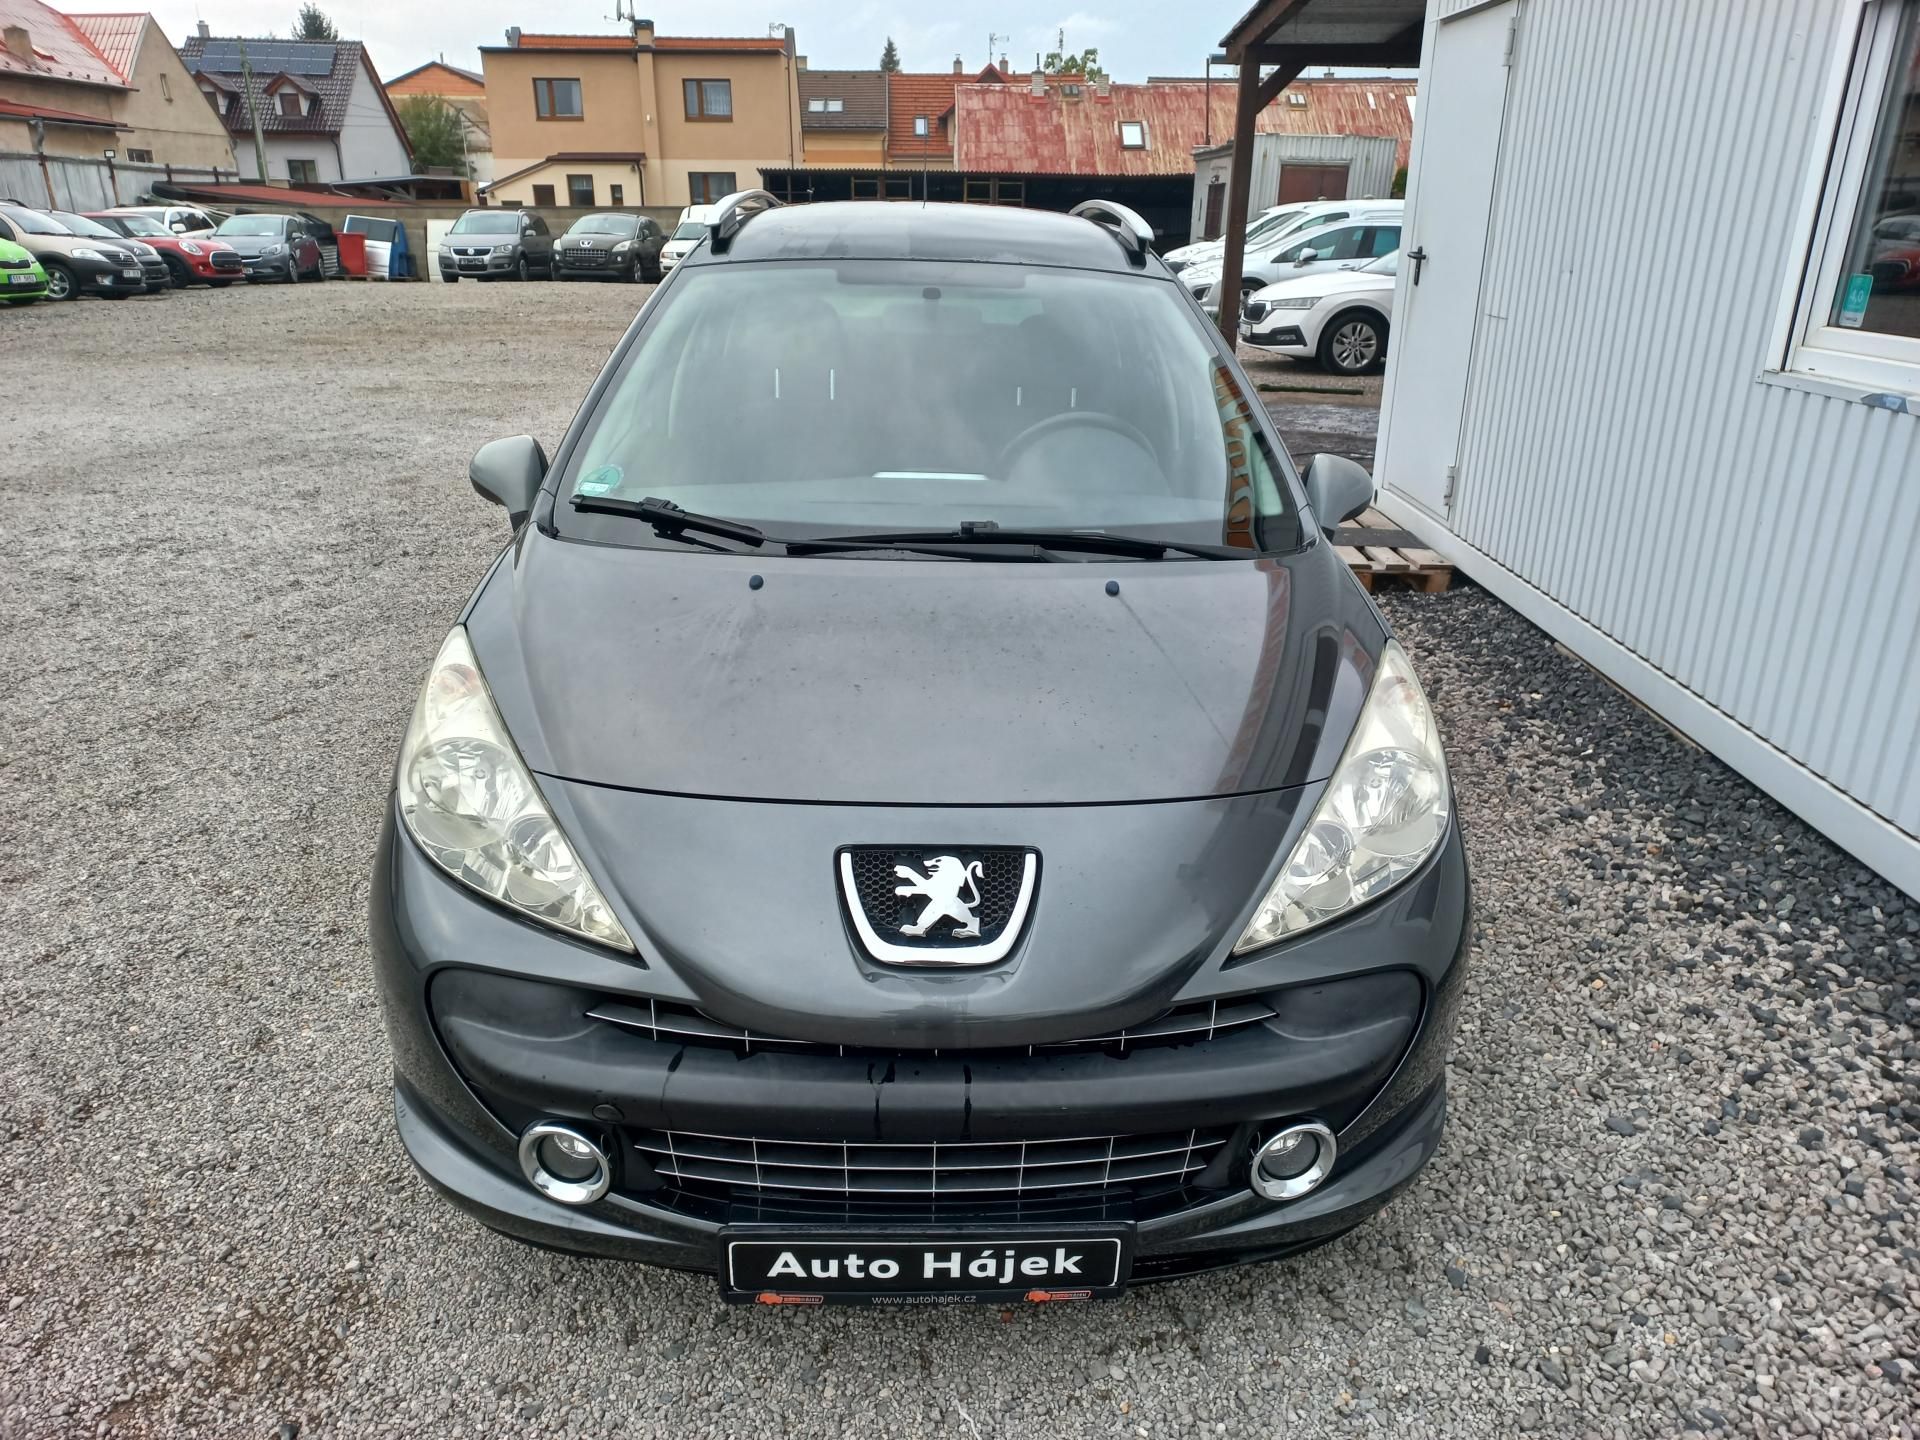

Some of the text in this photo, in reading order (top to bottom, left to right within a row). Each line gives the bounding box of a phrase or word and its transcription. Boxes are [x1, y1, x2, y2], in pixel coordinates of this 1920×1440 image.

[767, 1248, 1083, 1284] Auto Hájek
[871, 1294, 977, 1305] www.autohajek.cz
